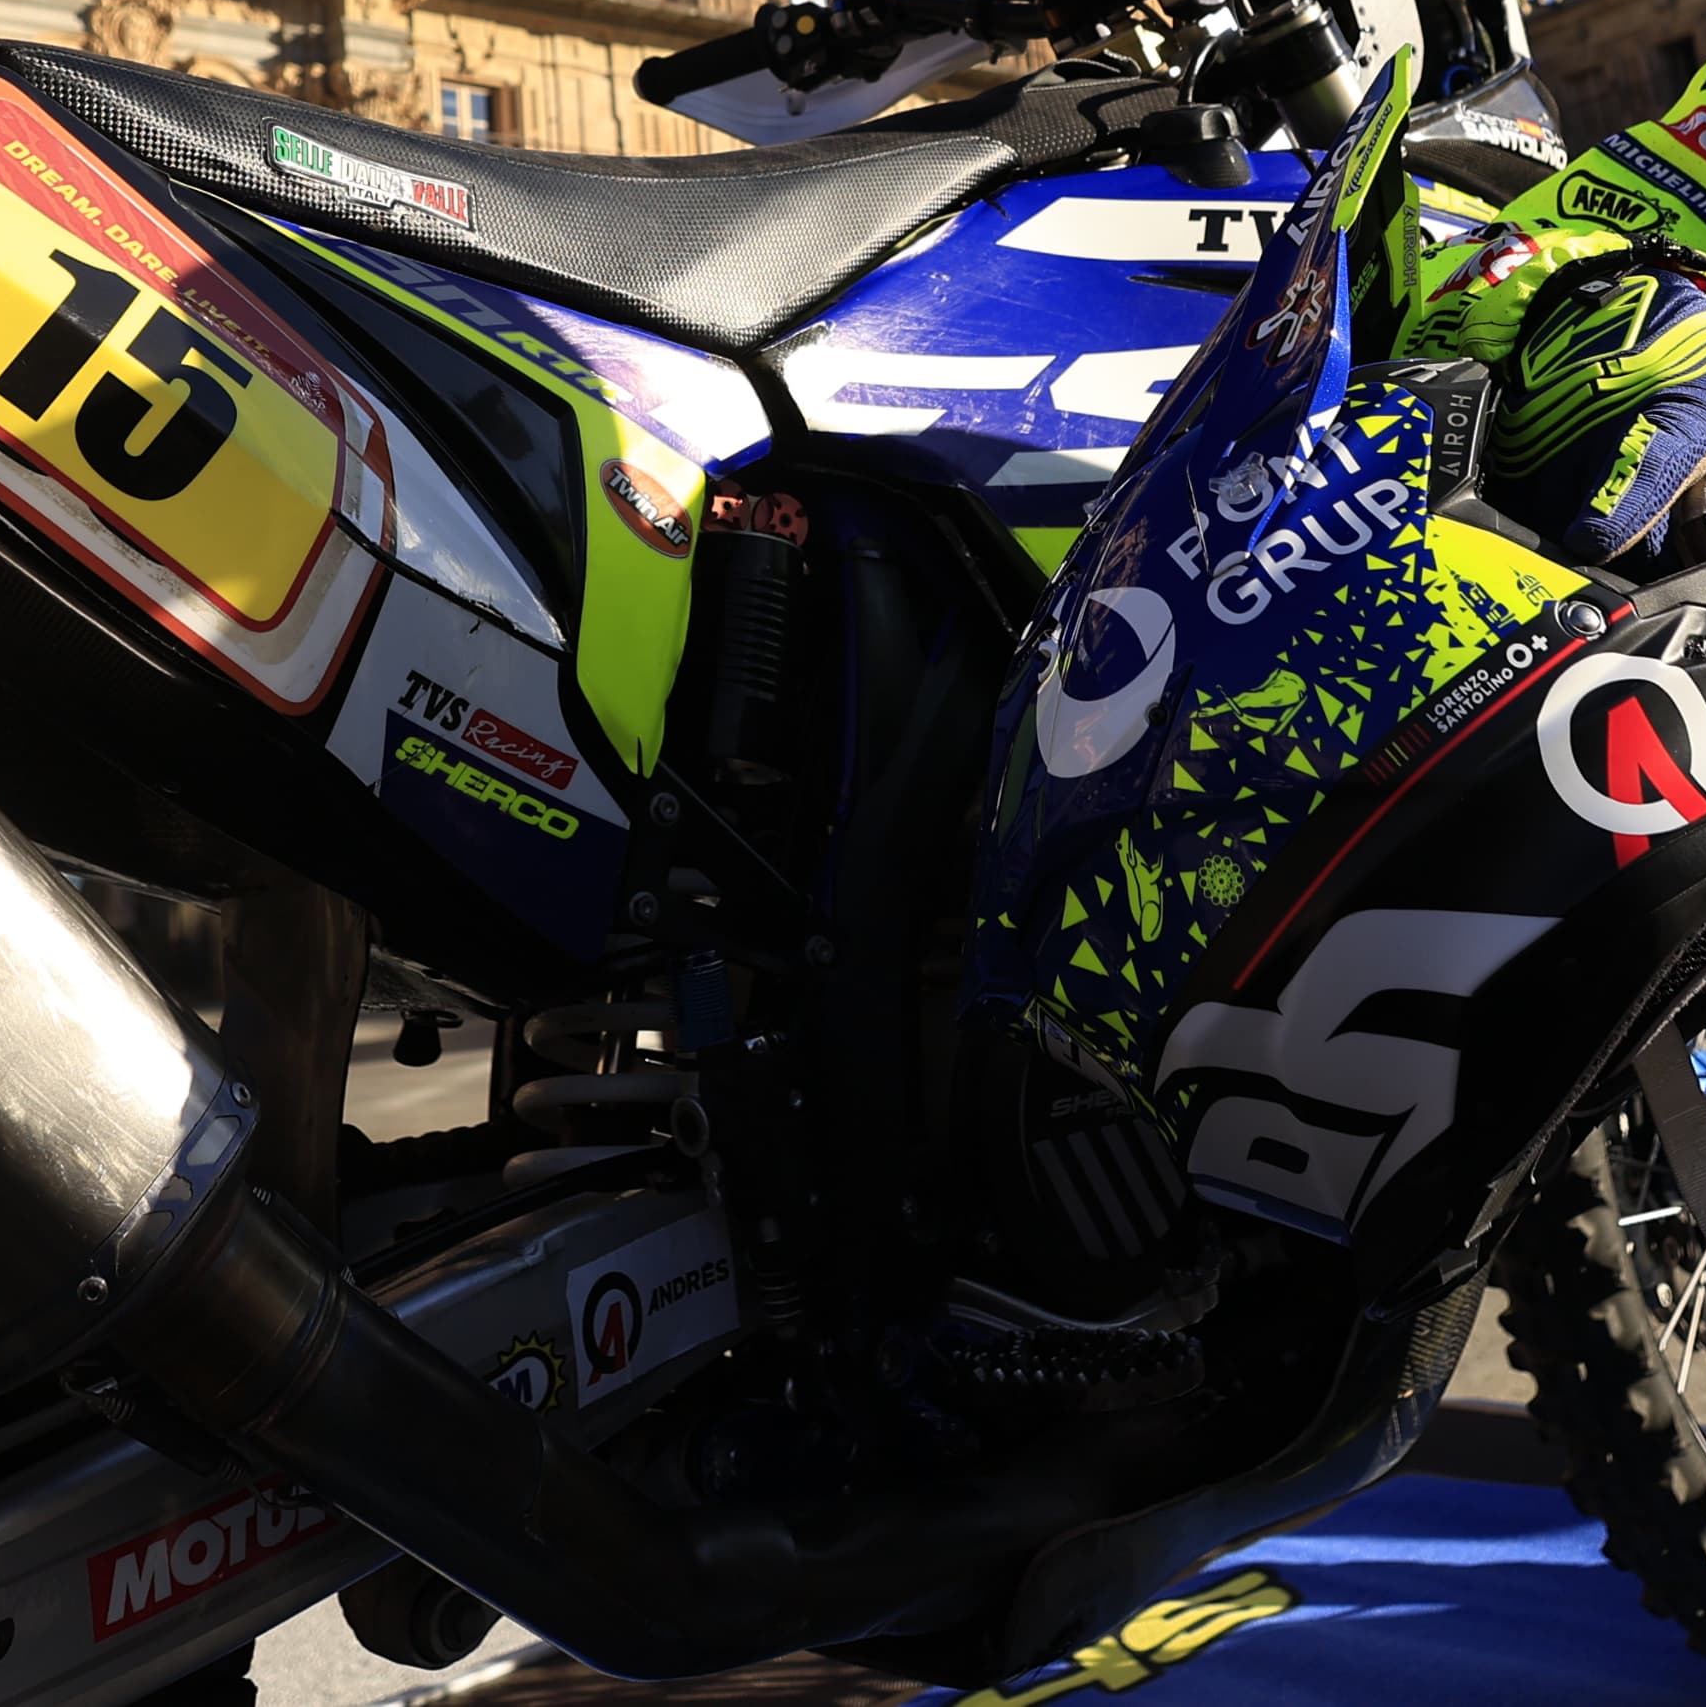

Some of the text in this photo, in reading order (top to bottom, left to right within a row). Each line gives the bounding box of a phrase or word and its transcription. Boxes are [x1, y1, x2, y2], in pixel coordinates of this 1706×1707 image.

[274, 128, 333, 176] SELLE
[1287, 100, 1376, 246] AIROH
[1462, 121, 1568, 171] SANTOLINO
[1573, 184, 1646, 224] AFAM
[1404, 205, 1417, 287] AIROH
[1439, 394, 1473, 477] AIROH
[1591, 413, 1658, 517] KENNY
[609, 467, 690, 545] Twin Air
[1206, 478, 1409, 625] GRUP
[398, 670, 573, 778] TVS Racing
[1426, 669, 1489, 723] LORENZO
[1437, 668, 1514, 733] SANTOLINO
[395, 737, 579, 839] SHERCO
